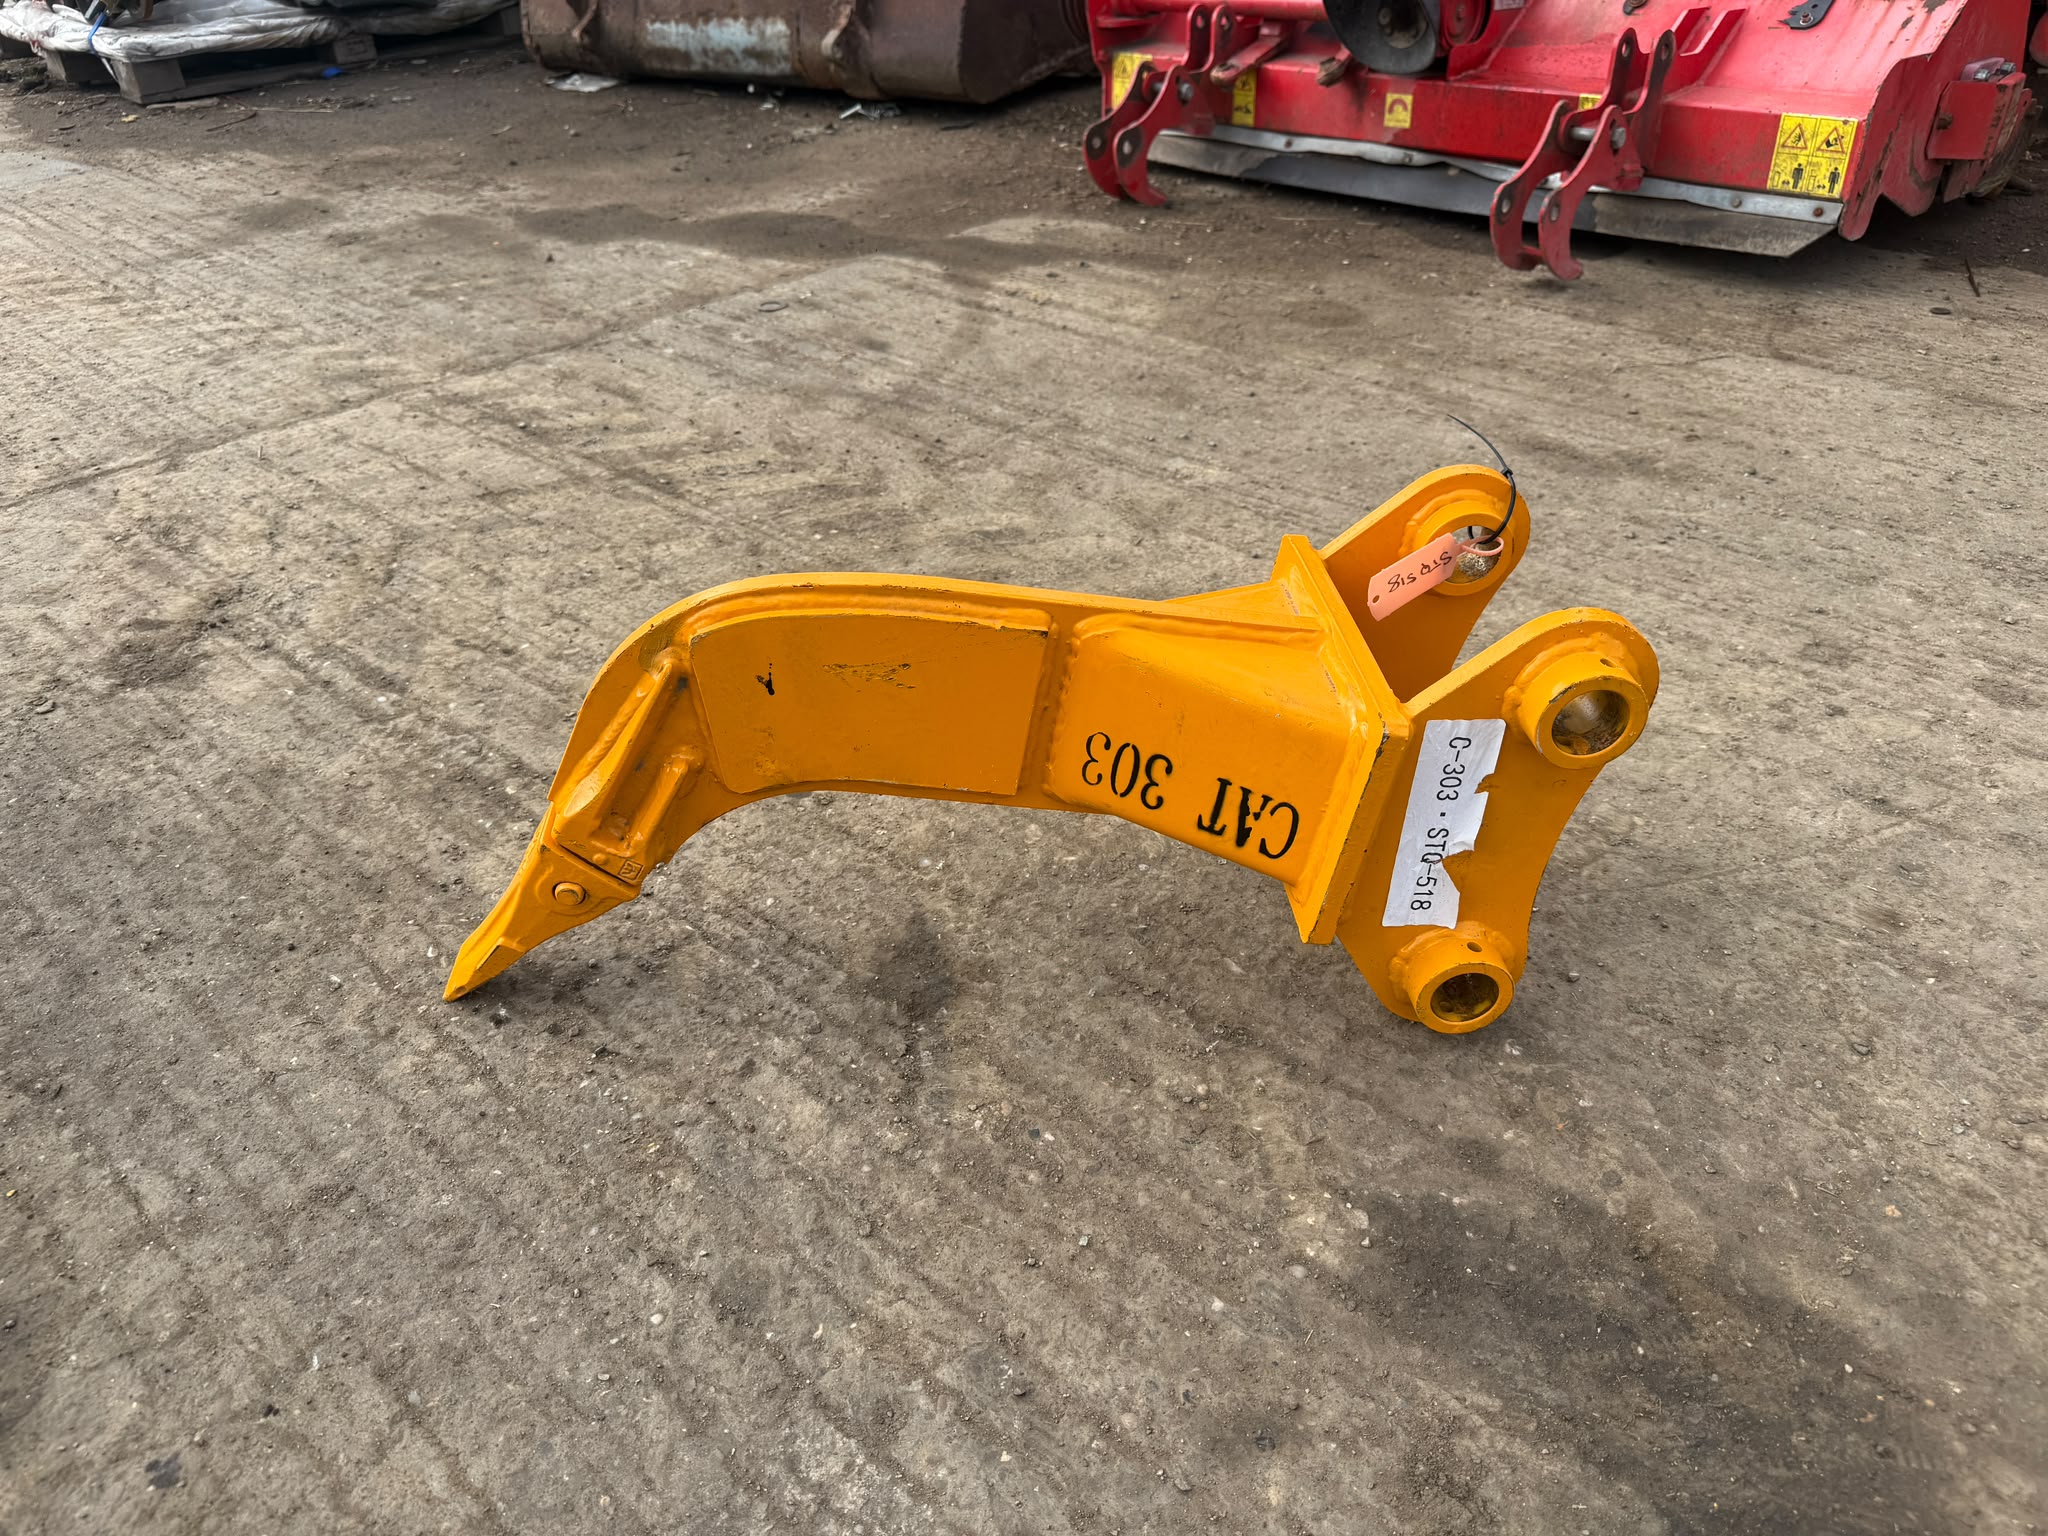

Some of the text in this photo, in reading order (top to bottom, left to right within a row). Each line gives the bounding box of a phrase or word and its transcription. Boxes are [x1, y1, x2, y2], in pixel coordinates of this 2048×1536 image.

[1387, 572, 1417, 593] 518
[1081, 731, 1299, 859] CAT 303
[1436, 736, 1472, 801] C-303
